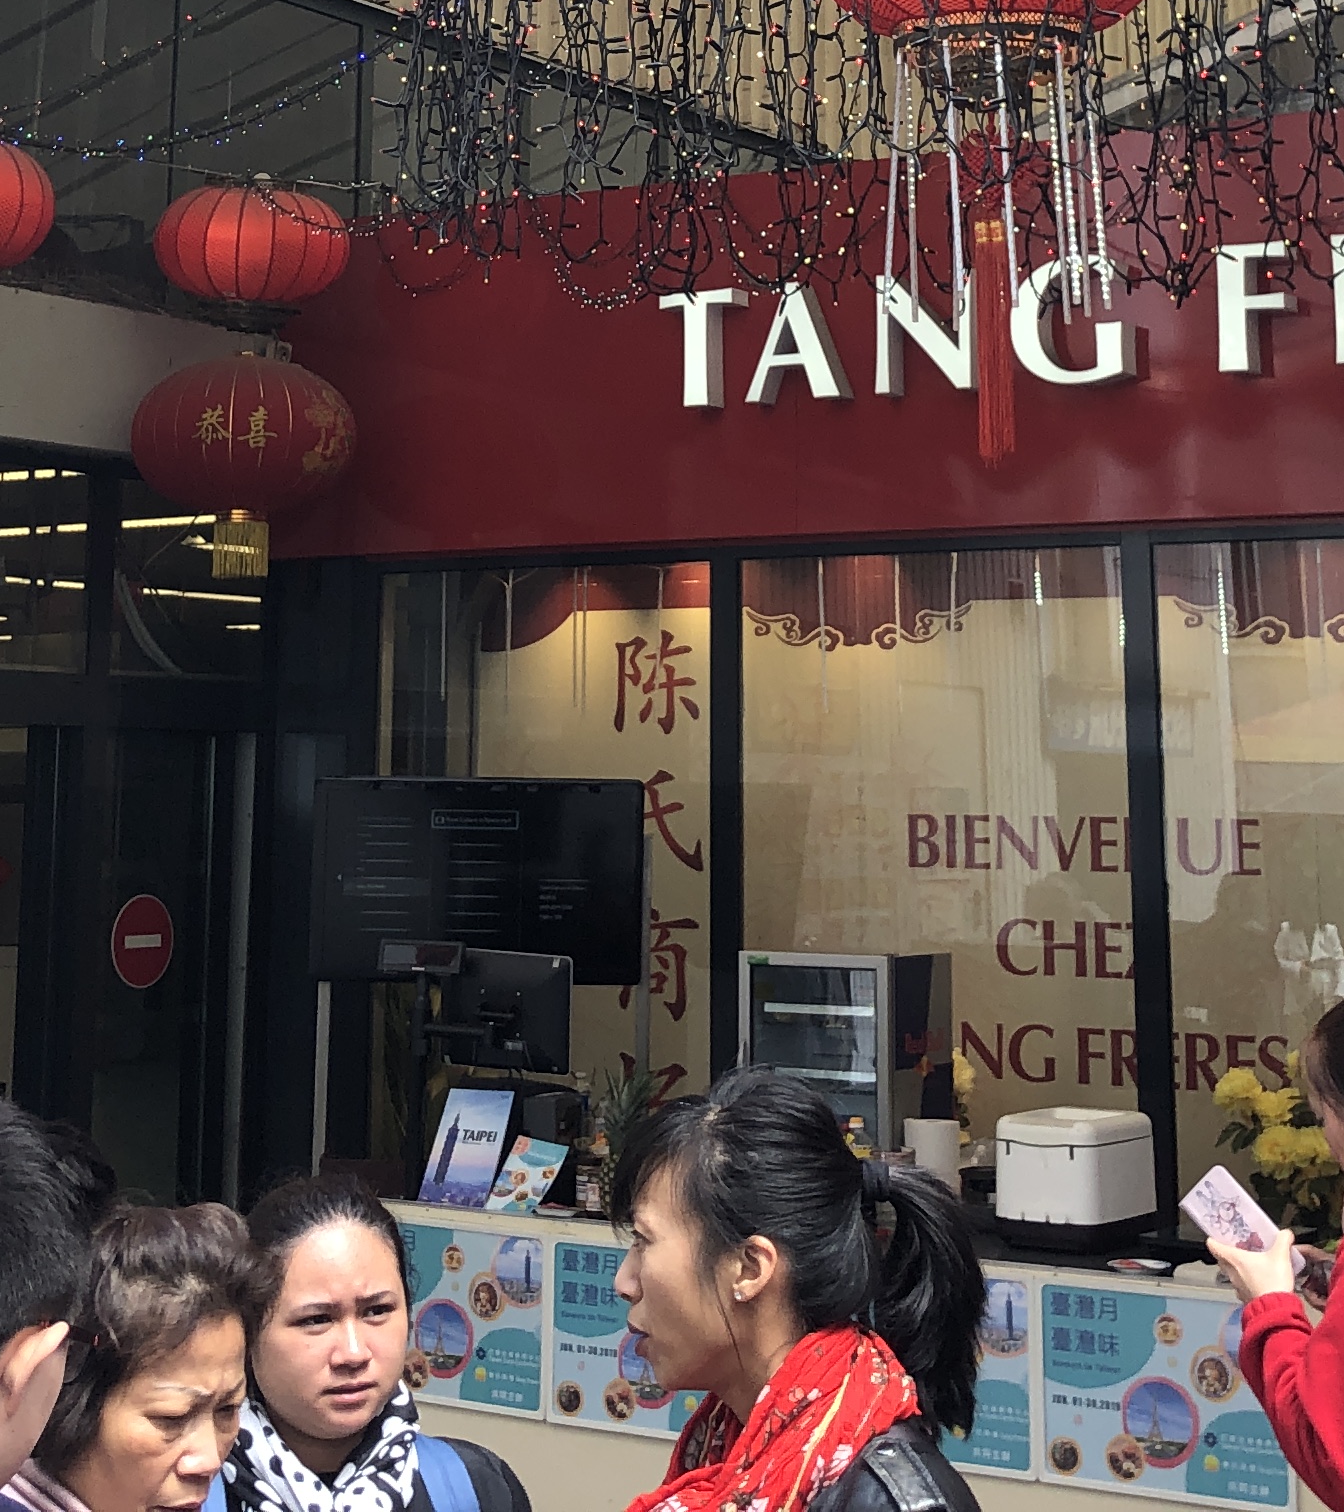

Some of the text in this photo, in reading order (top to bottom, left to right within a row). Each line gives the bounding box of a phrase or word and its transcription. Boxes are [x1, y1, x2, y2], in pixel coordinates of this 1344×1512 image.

[659, 251, 1138, 410] TANG
[192, 404, 277, 448] 恭喜
[906, 813, 1261, 876] BIENVEUE
[997, 918, 1135, 979] CHE
[961, 1021, 1293, 1091] NG FRRES
[462, 1129, 498, 1143] TAIPEI
